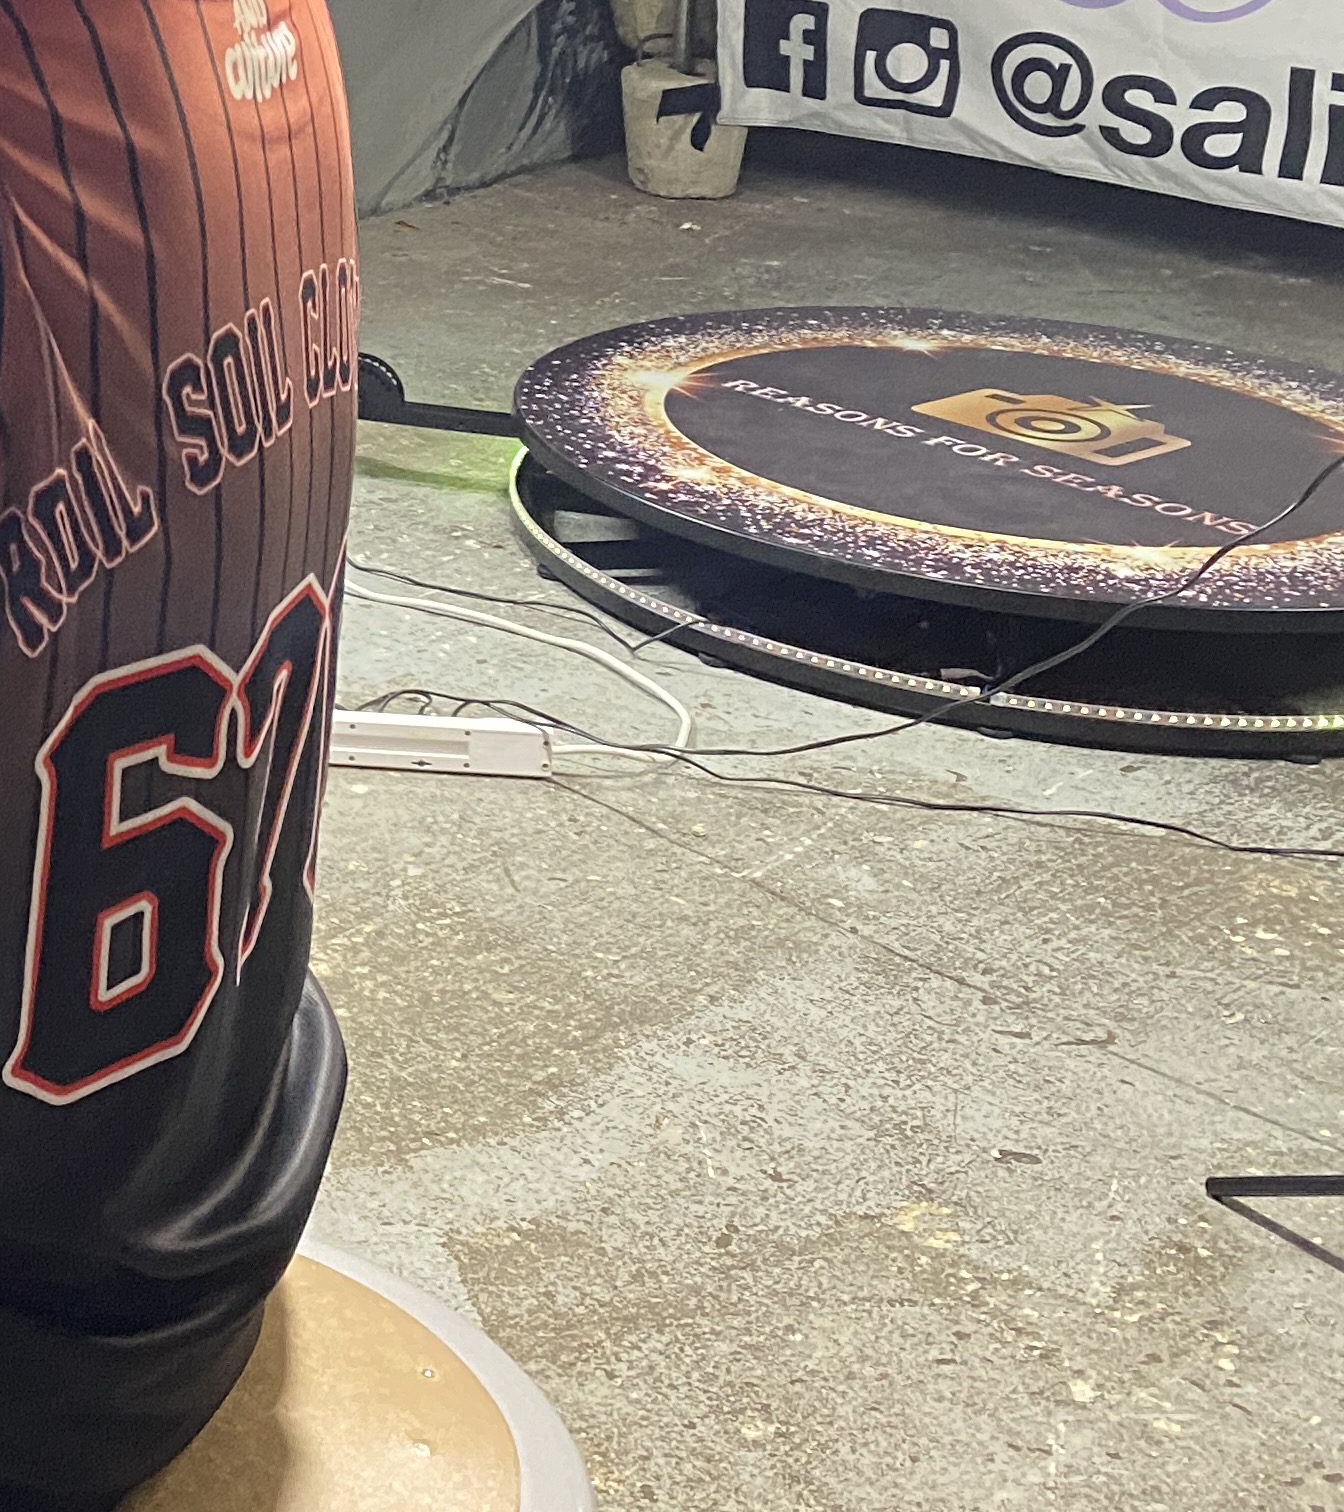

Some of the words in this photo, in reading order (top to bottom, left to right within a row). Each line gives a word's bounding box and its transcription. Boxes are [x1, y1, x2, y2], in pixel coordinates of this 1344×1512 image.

[163, 297, 294, 496] SOIL
[721, 378, 925, 439] REASONS
[919, 434, 1020, 467] FOR
[1019, 463, 1260, 536] SEASONS
